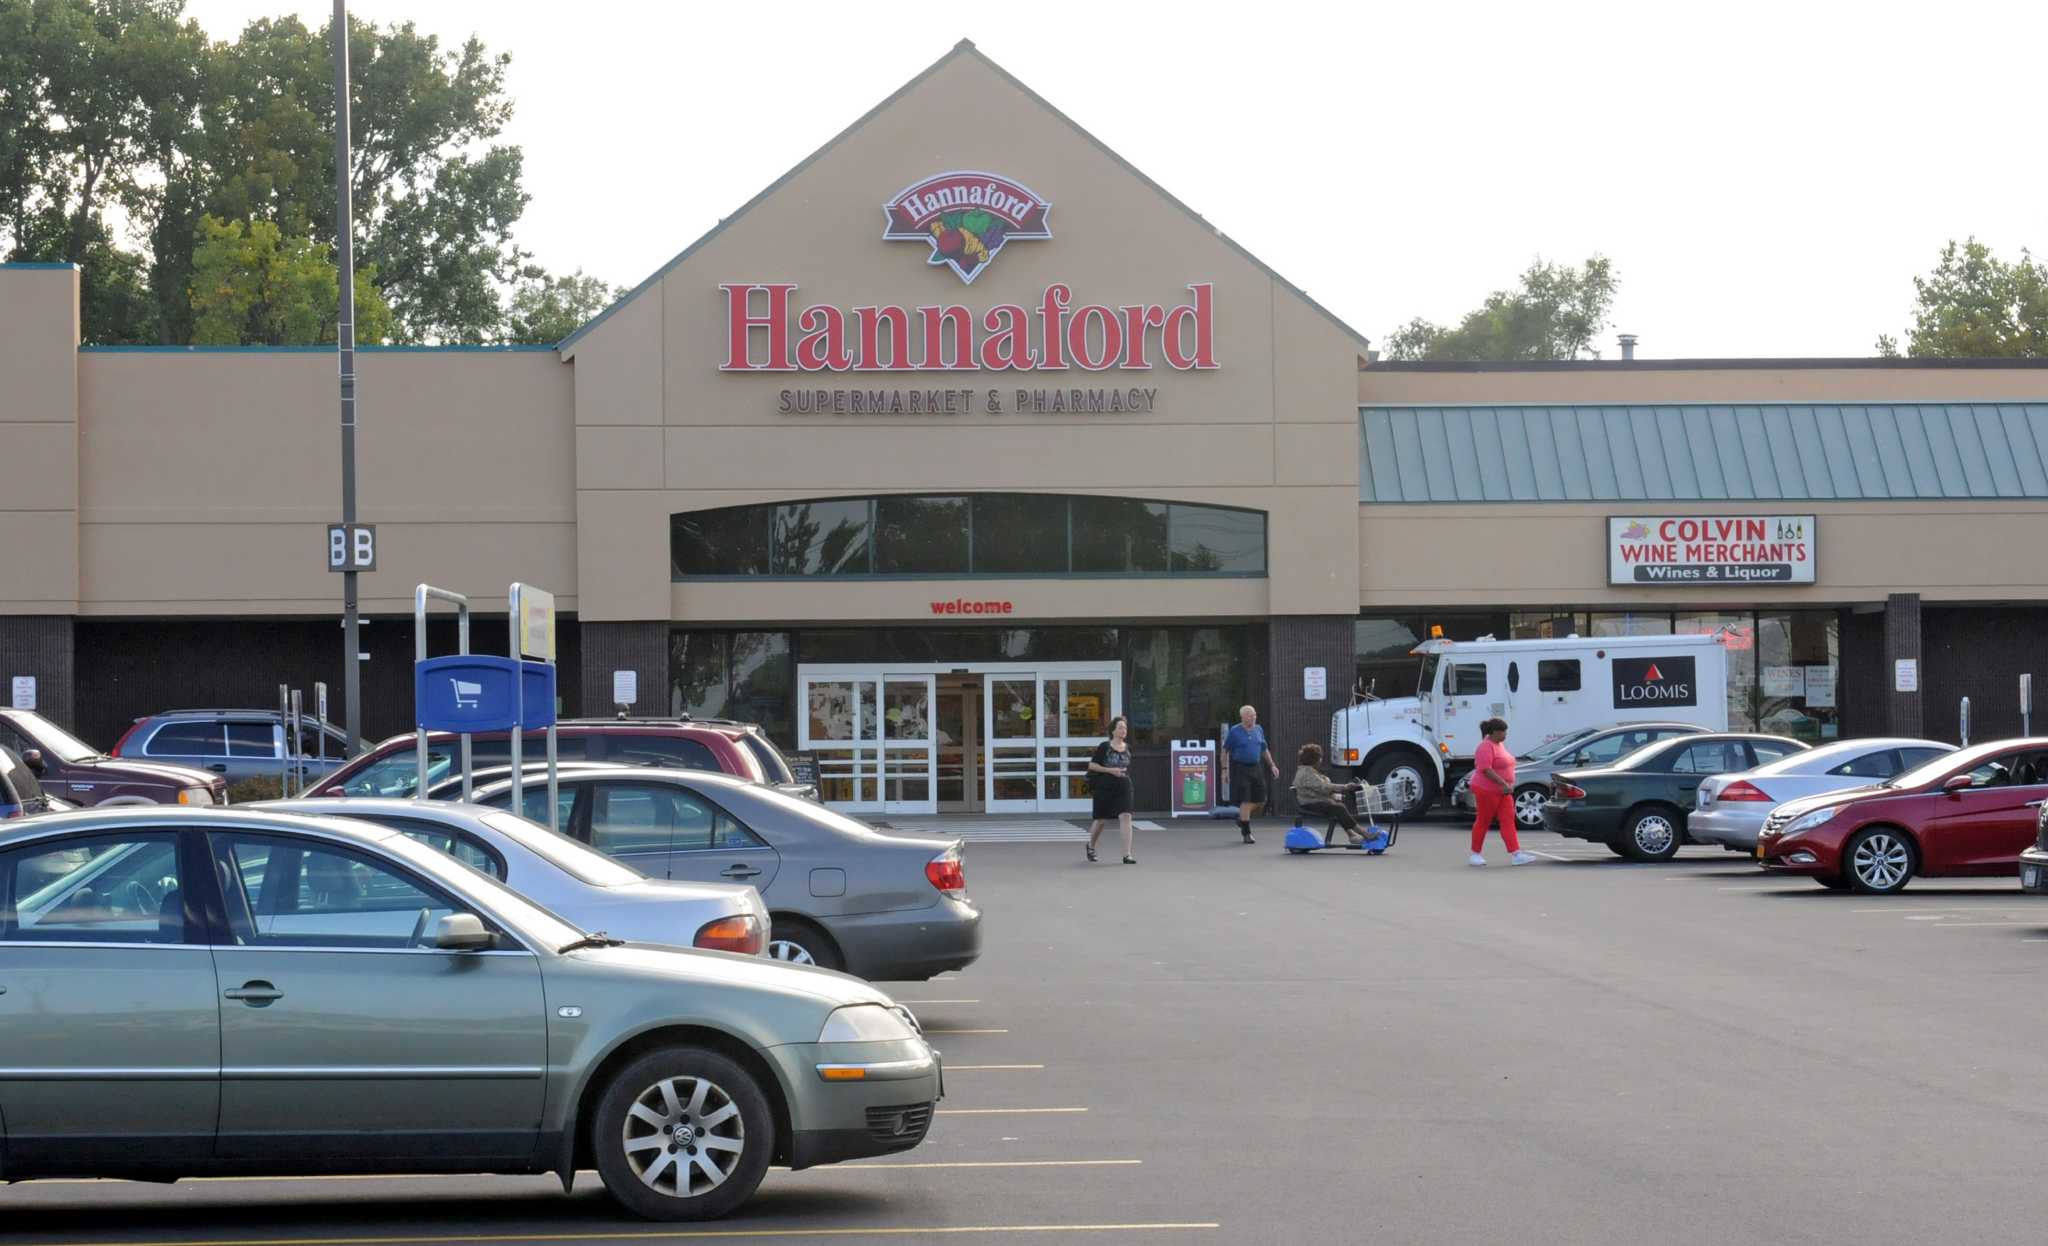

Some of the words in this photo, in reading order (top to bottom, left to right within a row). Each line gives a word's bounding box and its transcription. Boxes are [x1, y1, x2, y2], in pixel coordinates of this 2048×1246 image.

[900, 183, 1034, 221] Hannaford
[718, 283, 1220, 372] Hannaford
[779, 389, 973, 414] SUPERMARKET
[987, 389, 1001, 413] &
[1016, 388, 1158, 412] PHARMACY
[1659, 519, 1767, 542] COLVIN
[331, 529, 346, 566] B
[354, 528, 373, 566] B
[1619, 544, 1678, 563] WINE
[1686, 543, 1806, 563] MERCHANTS
[1646, 566, 1700, 579] Wines
[1706, 566, 1719, 578] &
[1725, 565, 1780, 581] Liquor
[931, 599, 1012, 614] welcome
[1620, 684, 1689, 700] LOOMIS
[1178, 755, 1209, 765] STOP
